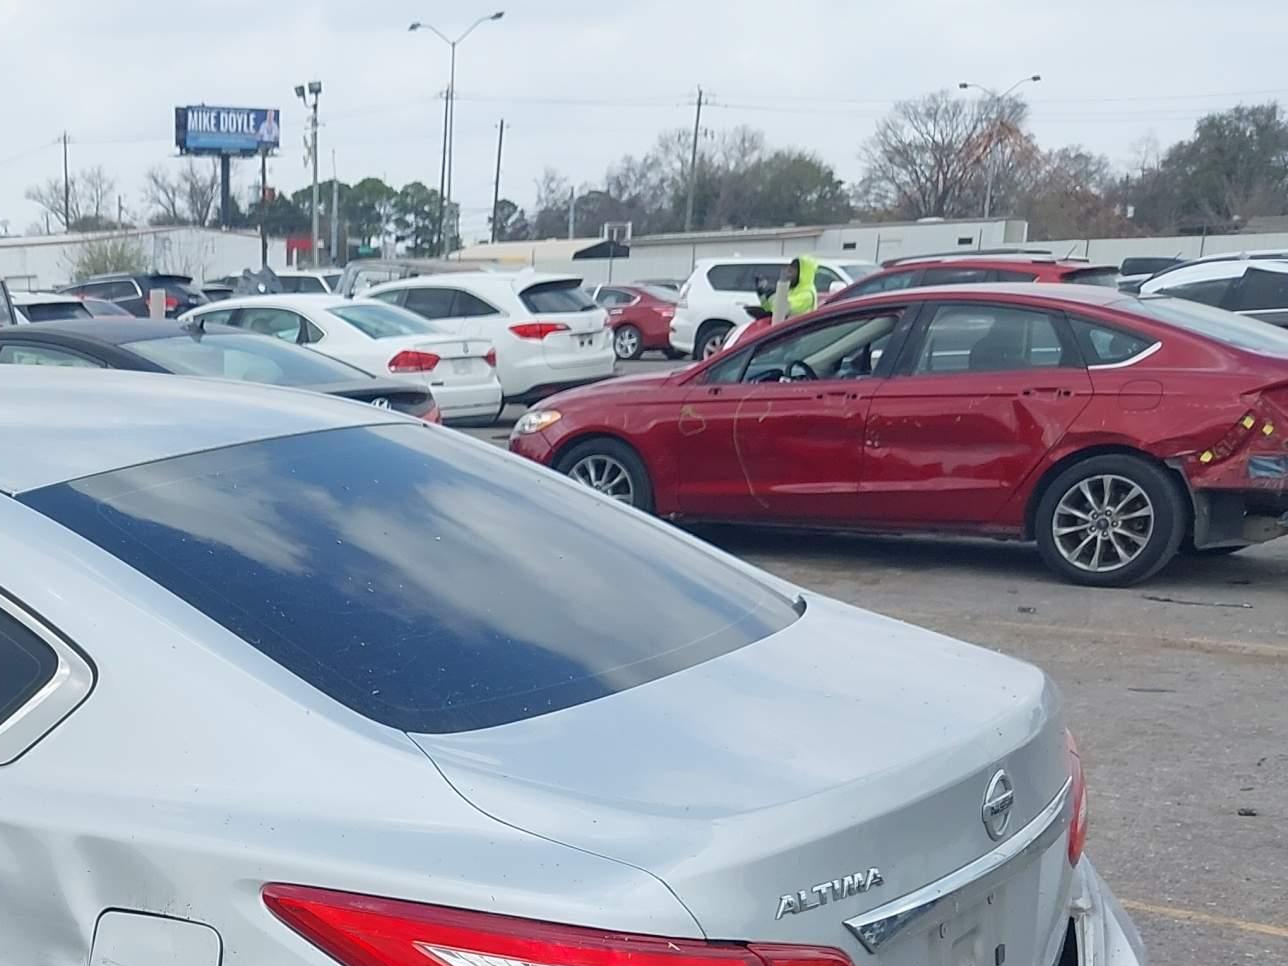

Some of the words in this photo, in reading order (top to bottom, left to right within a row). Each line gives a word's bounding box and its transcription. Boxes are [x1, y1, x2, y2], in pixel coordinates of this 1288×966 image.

[187, 110, 216, 132] MIKE
[220, 112, 256, 134] DOYLE
[774, 867, 884, 920] ALTIMA
